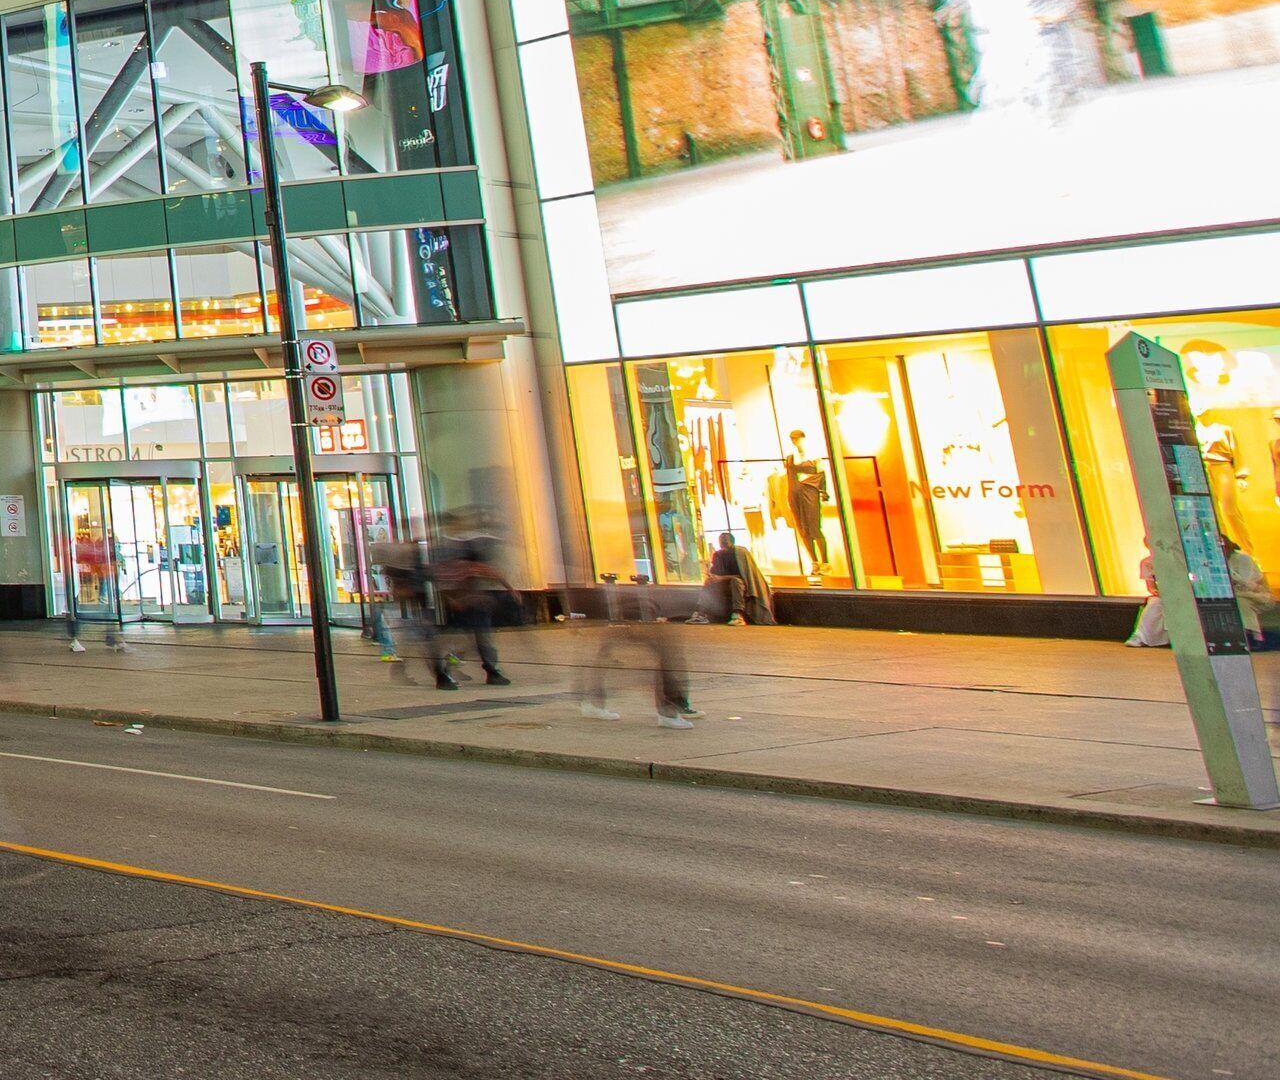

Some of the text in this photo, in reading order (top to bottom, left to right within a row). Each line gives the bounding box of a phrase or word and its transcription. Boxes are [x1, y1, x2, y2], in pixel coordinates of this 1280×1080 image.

[65, 446, 140, 461] STROM
[909, 480, 1056, 499] New Form
